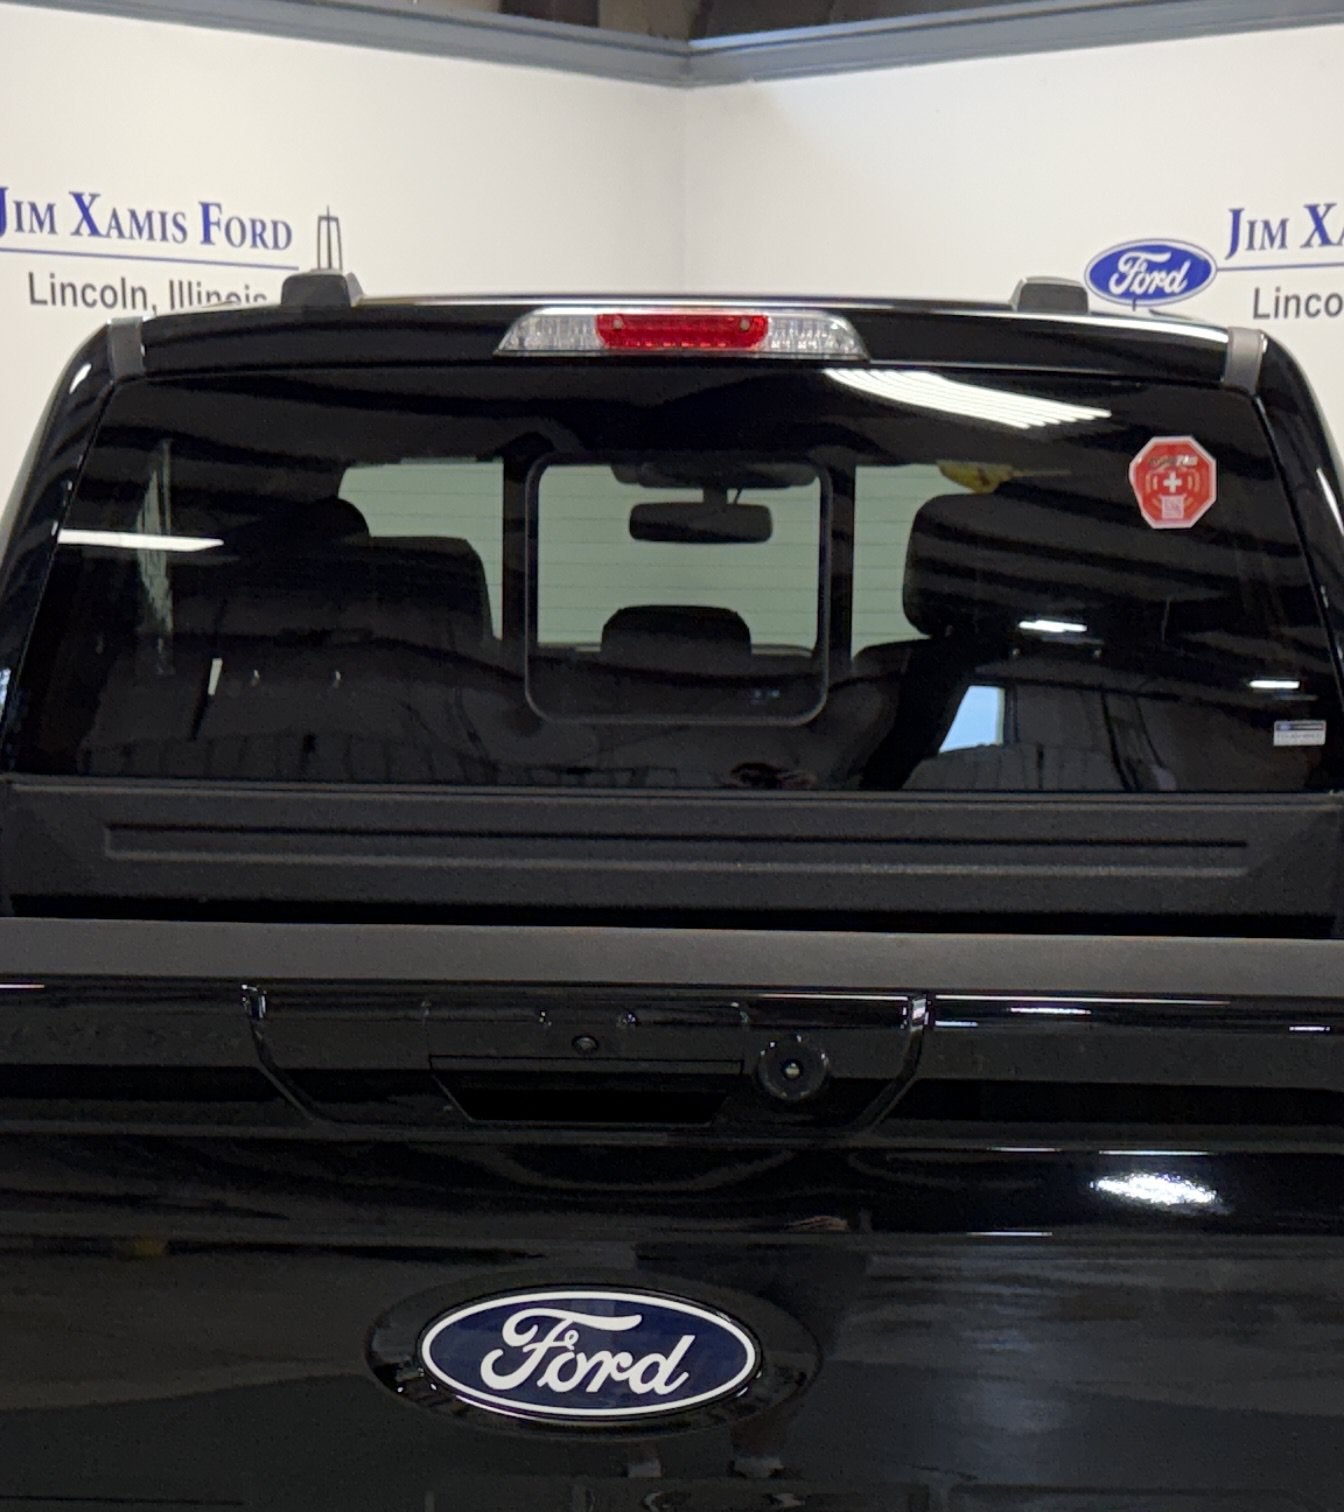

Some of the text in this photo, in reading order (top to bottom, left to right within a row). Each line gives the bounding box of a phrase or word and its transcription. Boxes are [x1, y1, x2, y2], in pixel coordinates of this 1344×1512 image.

[69, 191, 188, 244] XAMIS
[199, 201, 293, 250] FORD
[1224, 207, 1289, 260] JIM
[28, 271, 156, 314] Lincoln,
[1109, 252, 1191, 296] Ford
[480, 1308, 696, 1396] Ford
